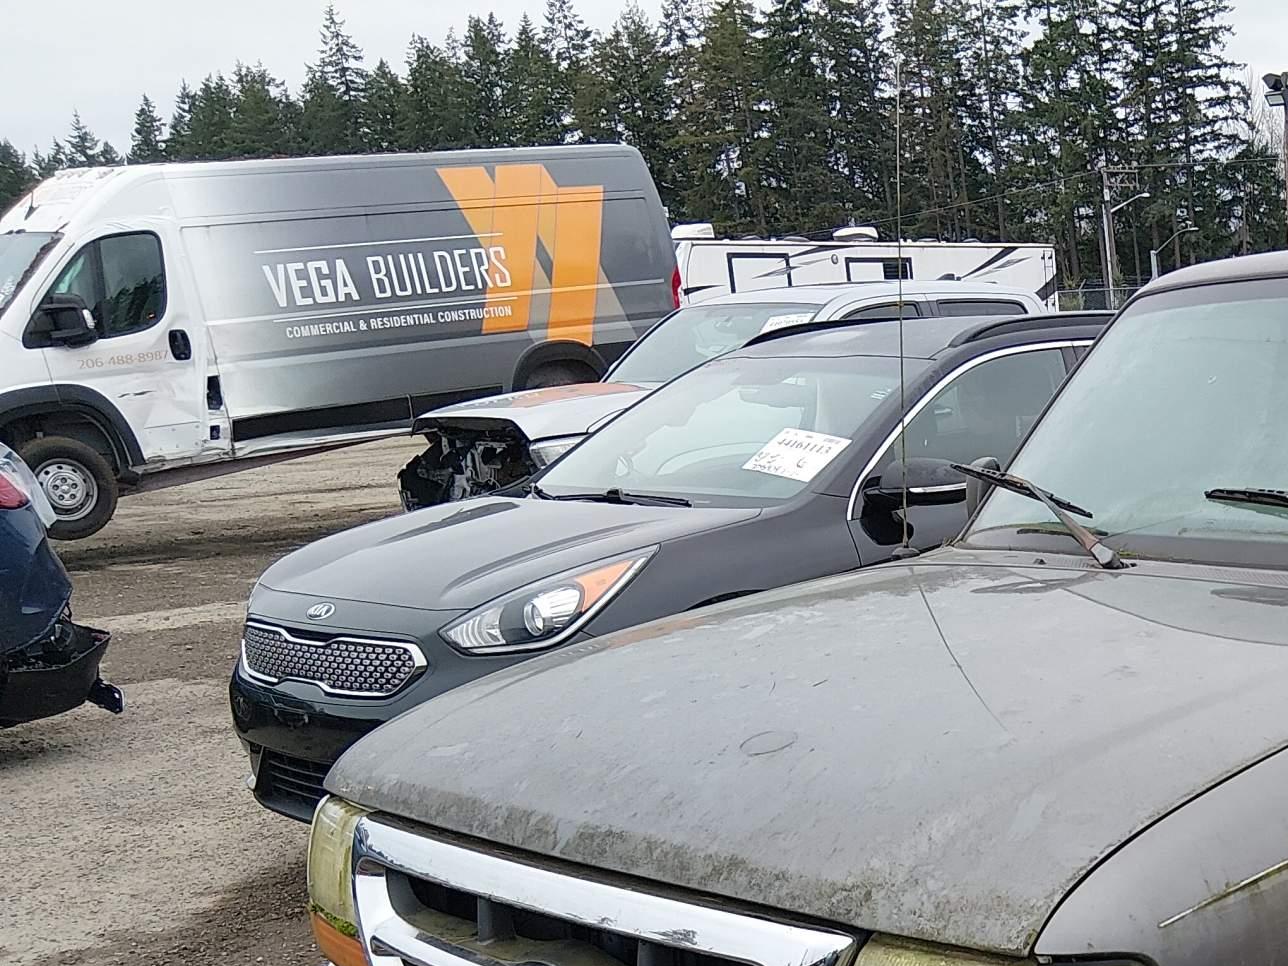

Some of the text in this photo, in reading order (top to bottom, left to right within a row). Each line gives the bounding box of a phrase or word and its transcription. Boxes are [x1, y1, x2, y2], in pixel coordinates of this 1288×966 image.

[263, 246, 512, 307] VEGA BUILDERS
[286, 305, 512, 338] COMMERCIAL & RESIDENTIAL CONSTRUCTION
